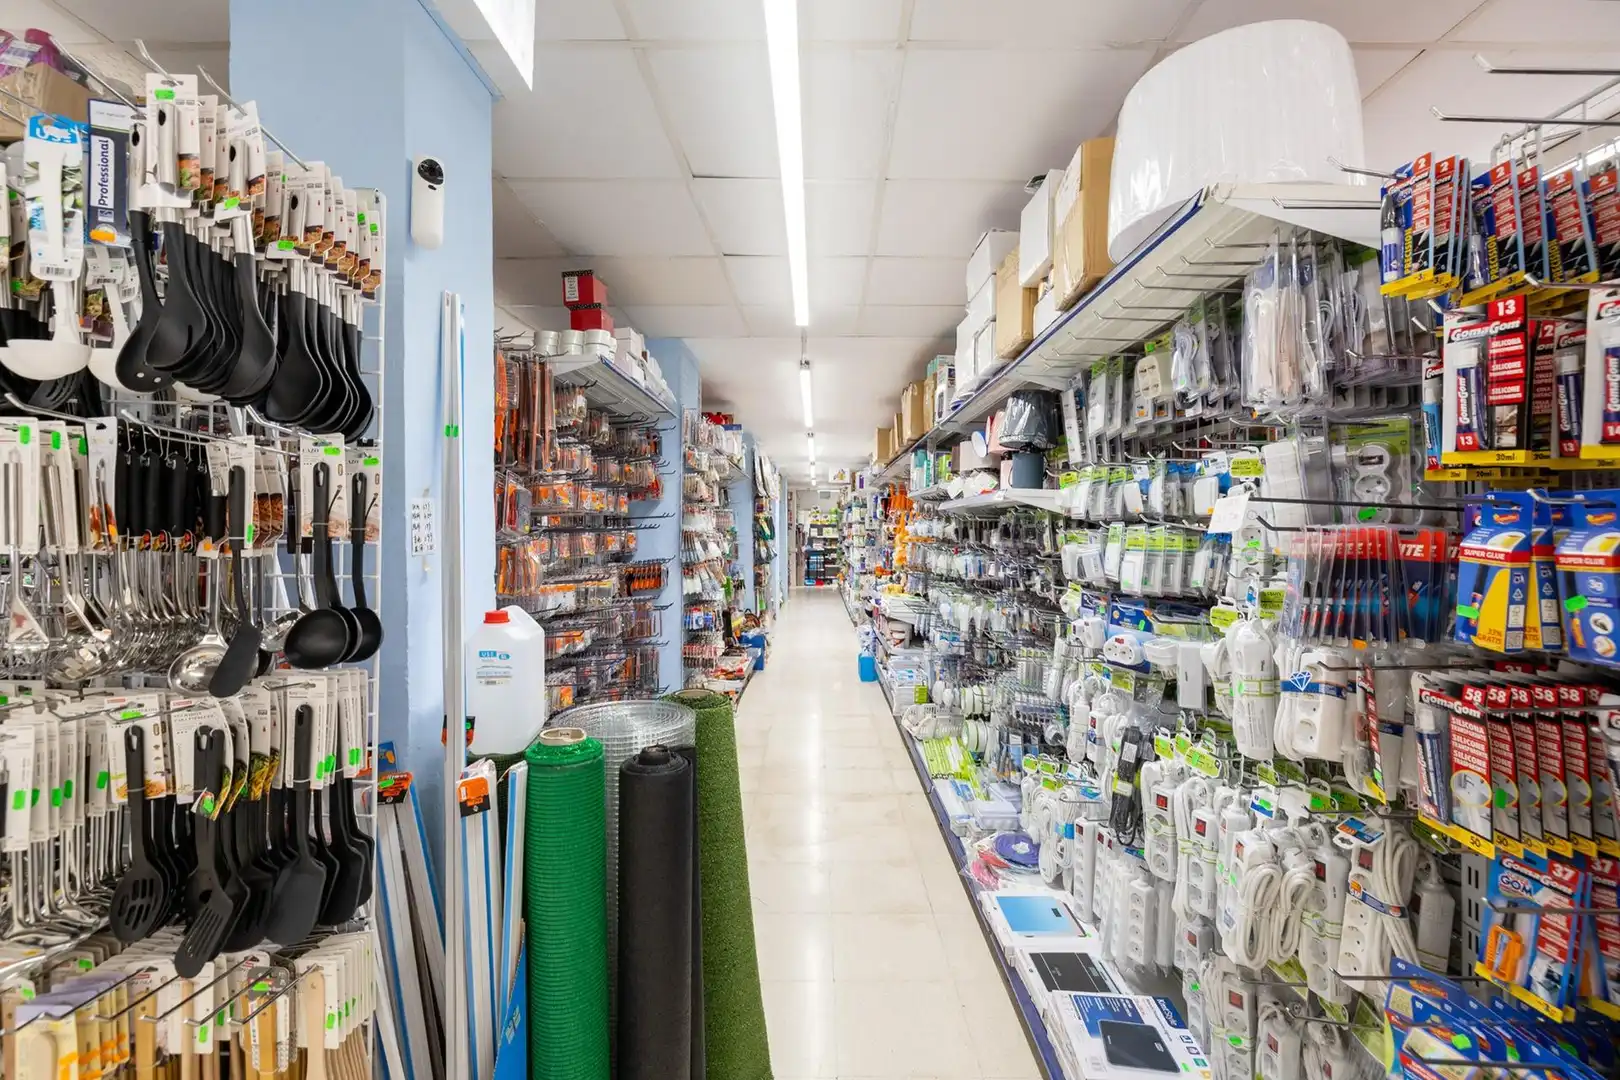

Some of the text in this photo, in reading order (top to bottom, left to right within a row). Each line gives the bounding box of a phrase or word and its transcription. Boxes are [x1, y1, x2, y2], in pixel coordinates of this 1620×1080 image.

[1418, 157, 1427, 169] 2
[1439, 161, 1450, 174] 2
[98, 138, 110, 207] Professional
[1496, 166, 1506, 179] 2
[1522, 170, 1533, 183] 2
[1597, 175, 1609, 188] 2
[1486, 234, 1500, 281] PRECISION
[1496, 299, 1516, 317] 13
[1450, 320, 1520, 342] GomaGom
[1457, 377, 1471, 425] GomaGom
[1459, 435, 1474, 446] 13
[1562, 442, 1574, 453] 13
[1495, 452, 1516, 462] 30ml
[1463, 548, 1485, 559] SUPER
[1486, 551, 1506, 560] GLUE
[1558, 557, 1606, 566] SUPER GLUE
[1464, 687, 1482, 703] 58
[1487, 687, 1507, 703] 58
[1510, 687, 1528, 703] 58
[1534, 687, 1555, 703] 58
[1559, 686, 1580, 702] 58
[1420, 690, 1481, 719] GomaGom
[1451, 716, 1485, 734] SILICONA
[1451, 733, 1486, 751] SILICONE
[1452, 749, 1487, 768] SILICONE
[1551, 862, 1576, 881] 37
[1590, 857, 1614, 874] 37
[1501, 857, 1574, 895] GomaGom
[1500, 875, 1533, 896] GOM
